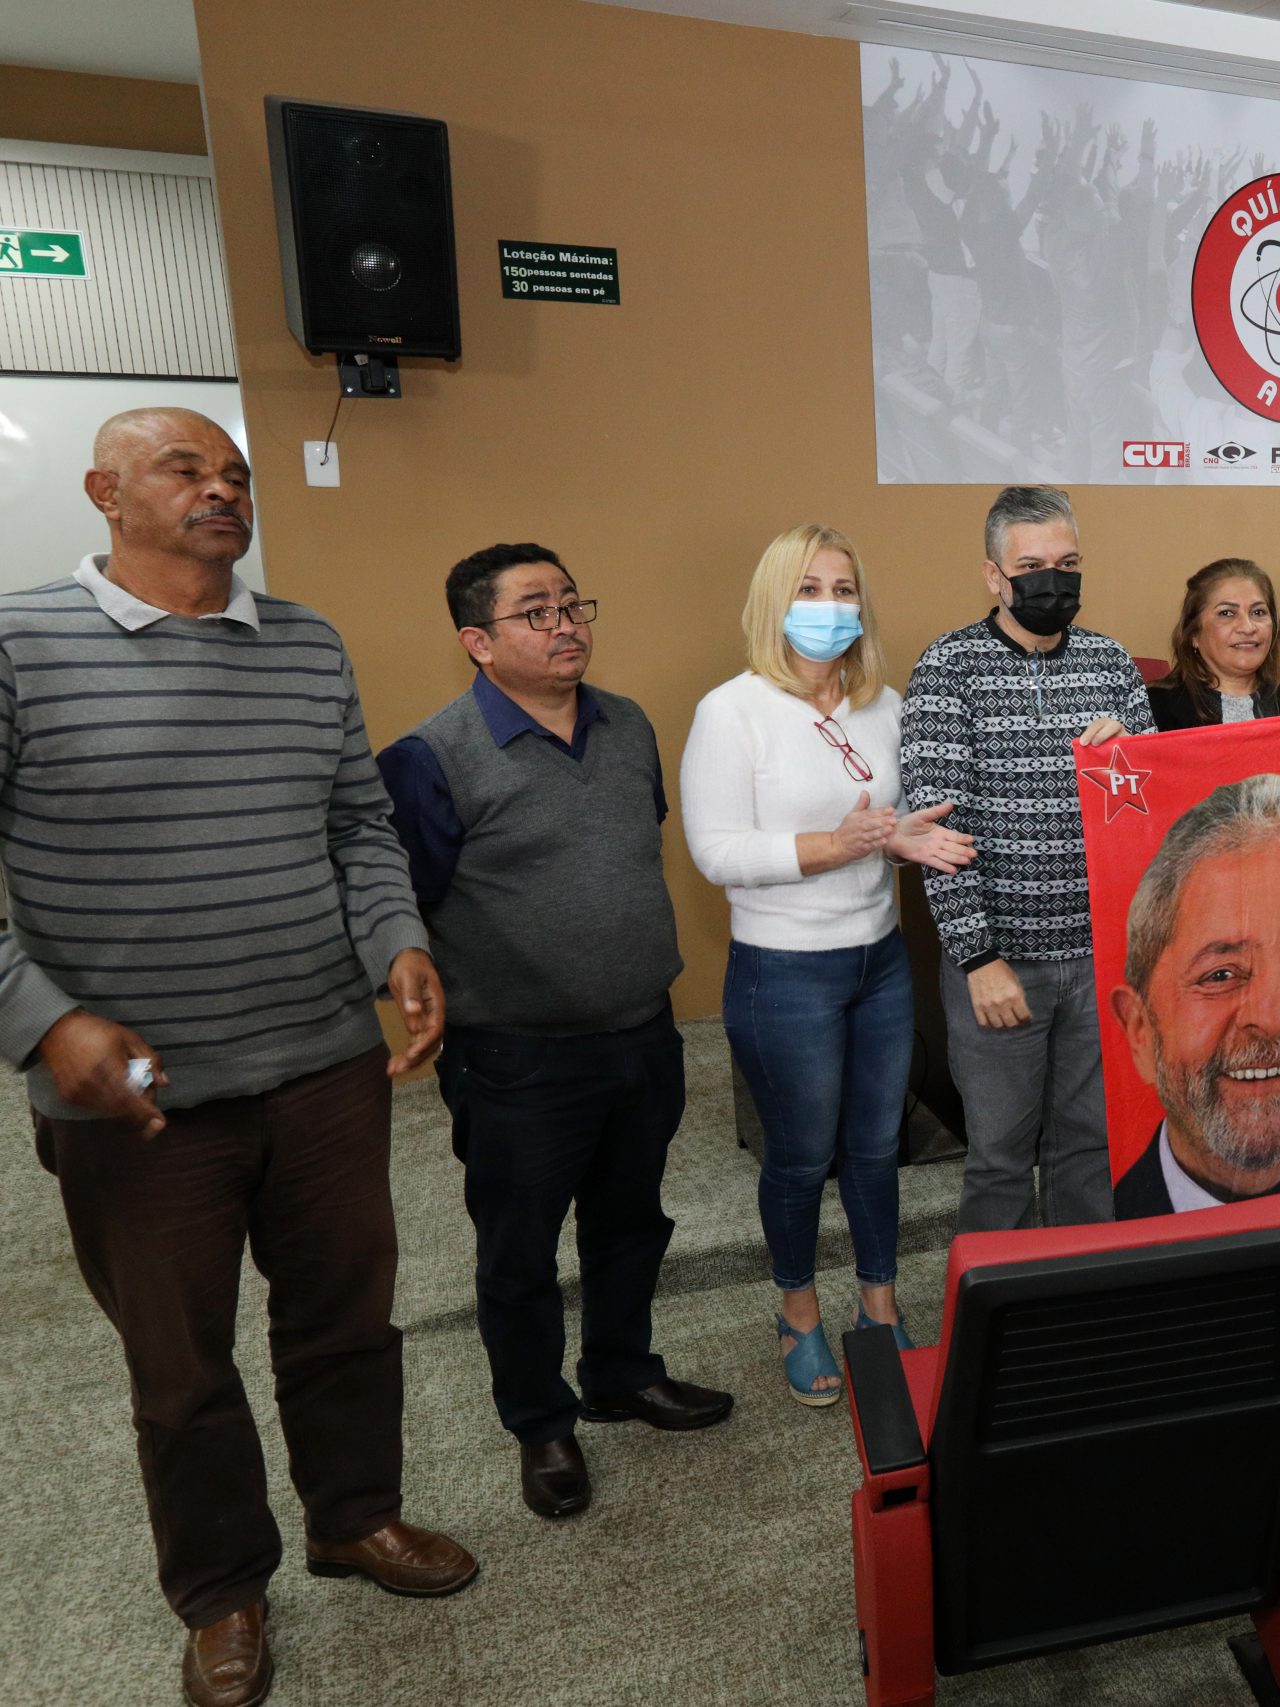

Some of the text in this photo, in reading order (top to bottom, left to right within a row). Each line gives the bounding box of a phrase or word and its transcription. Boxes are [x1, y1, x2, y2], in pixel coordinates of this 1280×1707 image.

[503, 247, 613, 266] Lotação Máxima:
[569, 271, 613, 281] sentadas
[512, 280, 605, 297] 30 pessoas em pé
[1123, 443, 1184, 467] CUT
[1203, 457, 1220, 465] CNQ
[1109, 773, 1140, 796] PT
